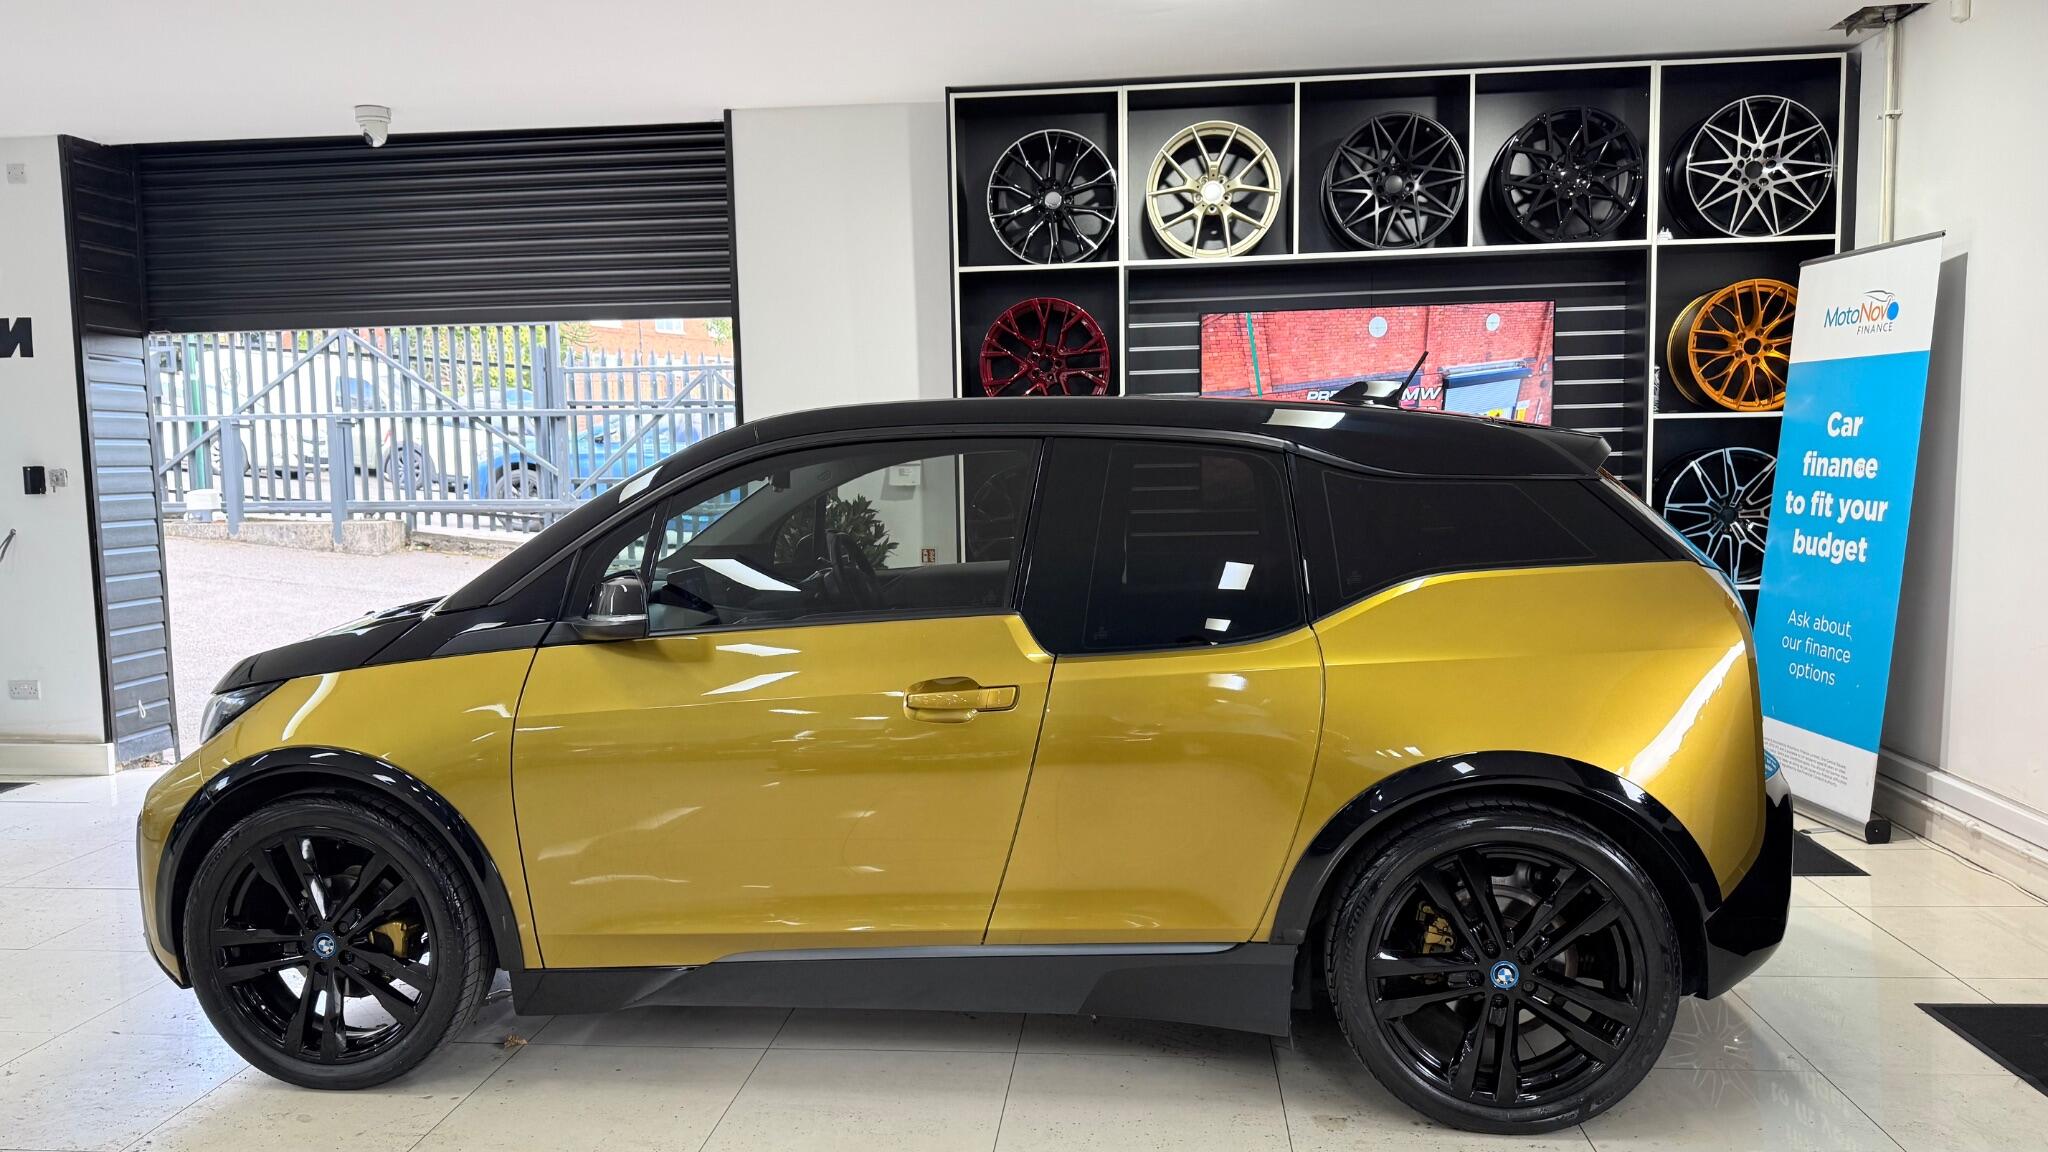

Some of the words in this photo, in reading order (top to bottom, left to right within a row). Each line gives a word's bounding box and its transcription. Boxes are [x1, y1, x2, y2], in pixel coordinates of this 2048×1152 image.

[1856, 322, 1893, 335] FINANCE
[1401, 387, 1442, 401] MW
[1827, 411, 1864, 437] Car
[1803, 450, 1878, 479] finance
[1785, 490, 1806, 515] to
[1810, 490, 1834, 517] fit
[1837, 498, 1888, 523] your
[1792, 528, 1868, 564] budget
[1787, 609, 1811, 629] Ask
[1813, 615, 1852, 637] about
[1781, 635, 1802, 651] our
[1805, 637, 1851, 663] finance
[1789, 662, 1836, 686] options
